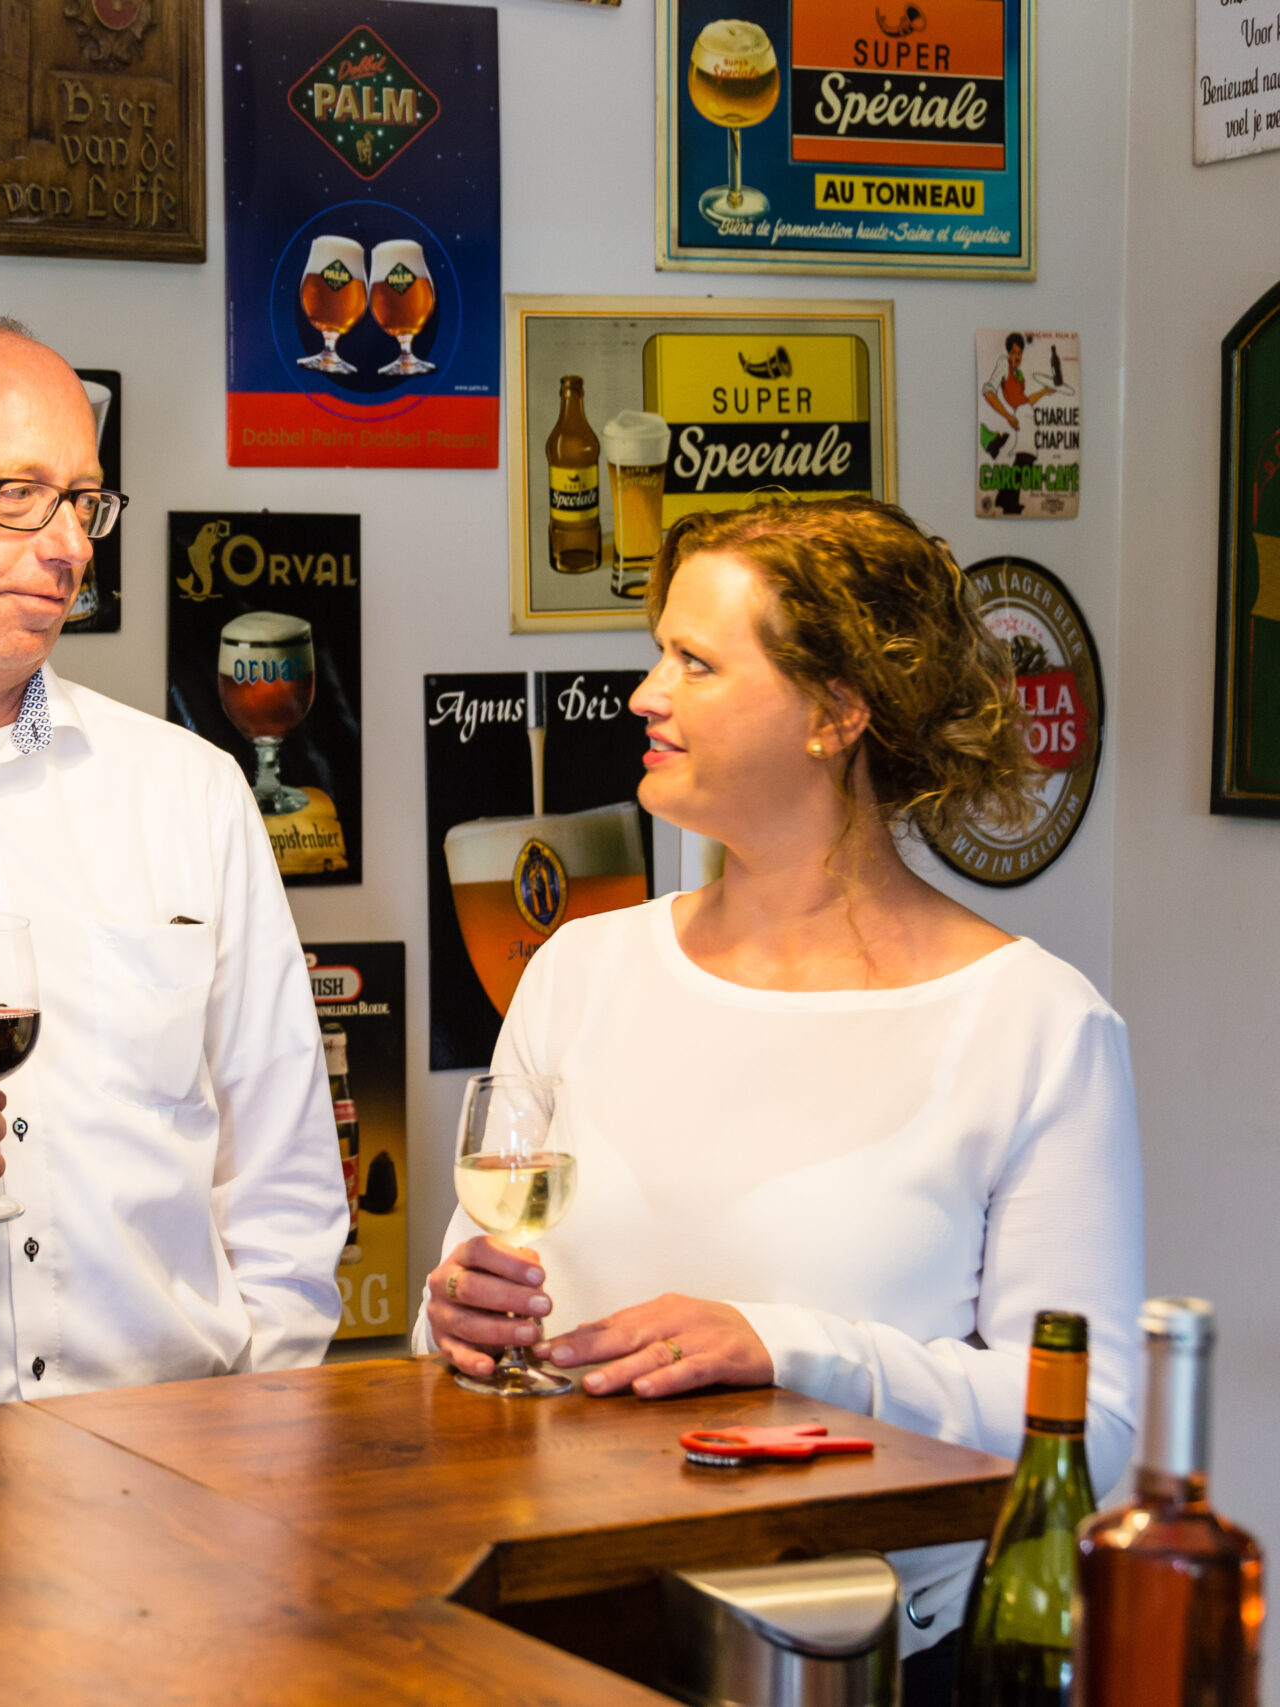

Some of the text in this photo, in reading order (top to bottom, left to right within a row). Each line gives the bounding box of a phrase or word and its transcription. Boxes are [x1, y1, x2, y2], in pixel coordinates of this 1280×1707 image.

[1241, 17, 1273, 48] Voor
[853, 39, 950, 71] SUPER
[60, 80, 156, 128] Bier
[314, 82, 416, 125] PALM
[815, 72, 988, 135] Spéciale
[1200, 67, 1259, 106] Benieuwd
[1225, 107, 1249, 139] voel
[1253, 108, 1262, 141] je
[61, 132, 176, 172] van de
[1, 180, 71, 216] van
[88, 172, 176, 226] Leffe
[823, 180, 976, 209] AU TONNEAU
[756, 220, 770, 237] de
[771, 218, 853, 245] fermentation
[936, 225, 950, 243] et
[952, 226, 1011, 249] digestive
[712, 387, 812, 414] SUPER
[1033, 407, 1080, 426] CHARLIE
[242, 428, 305, 447] Dobbel
[312, 429, 354, 447] Palm
[360, 430, 421, 448] Dobbel
[1033, 430, 1080, 450] CHAPLIN
[674, 424, 852, 491] Speciale
[222, 534, 358, 587] ORVAL
[975, 572, 1083, 657] M LAGER BEER
[428, 676, 622, 743] Agnus Dei
[1017, 685, 1075, 716] LLA
[1022, 720, 1077, 755] OIS
[270, 822, 339, 859] ppistenbier
[951, 793, 1081, 875] WED IN BELGIUM
[336, 1273, 390, 1327] RG
